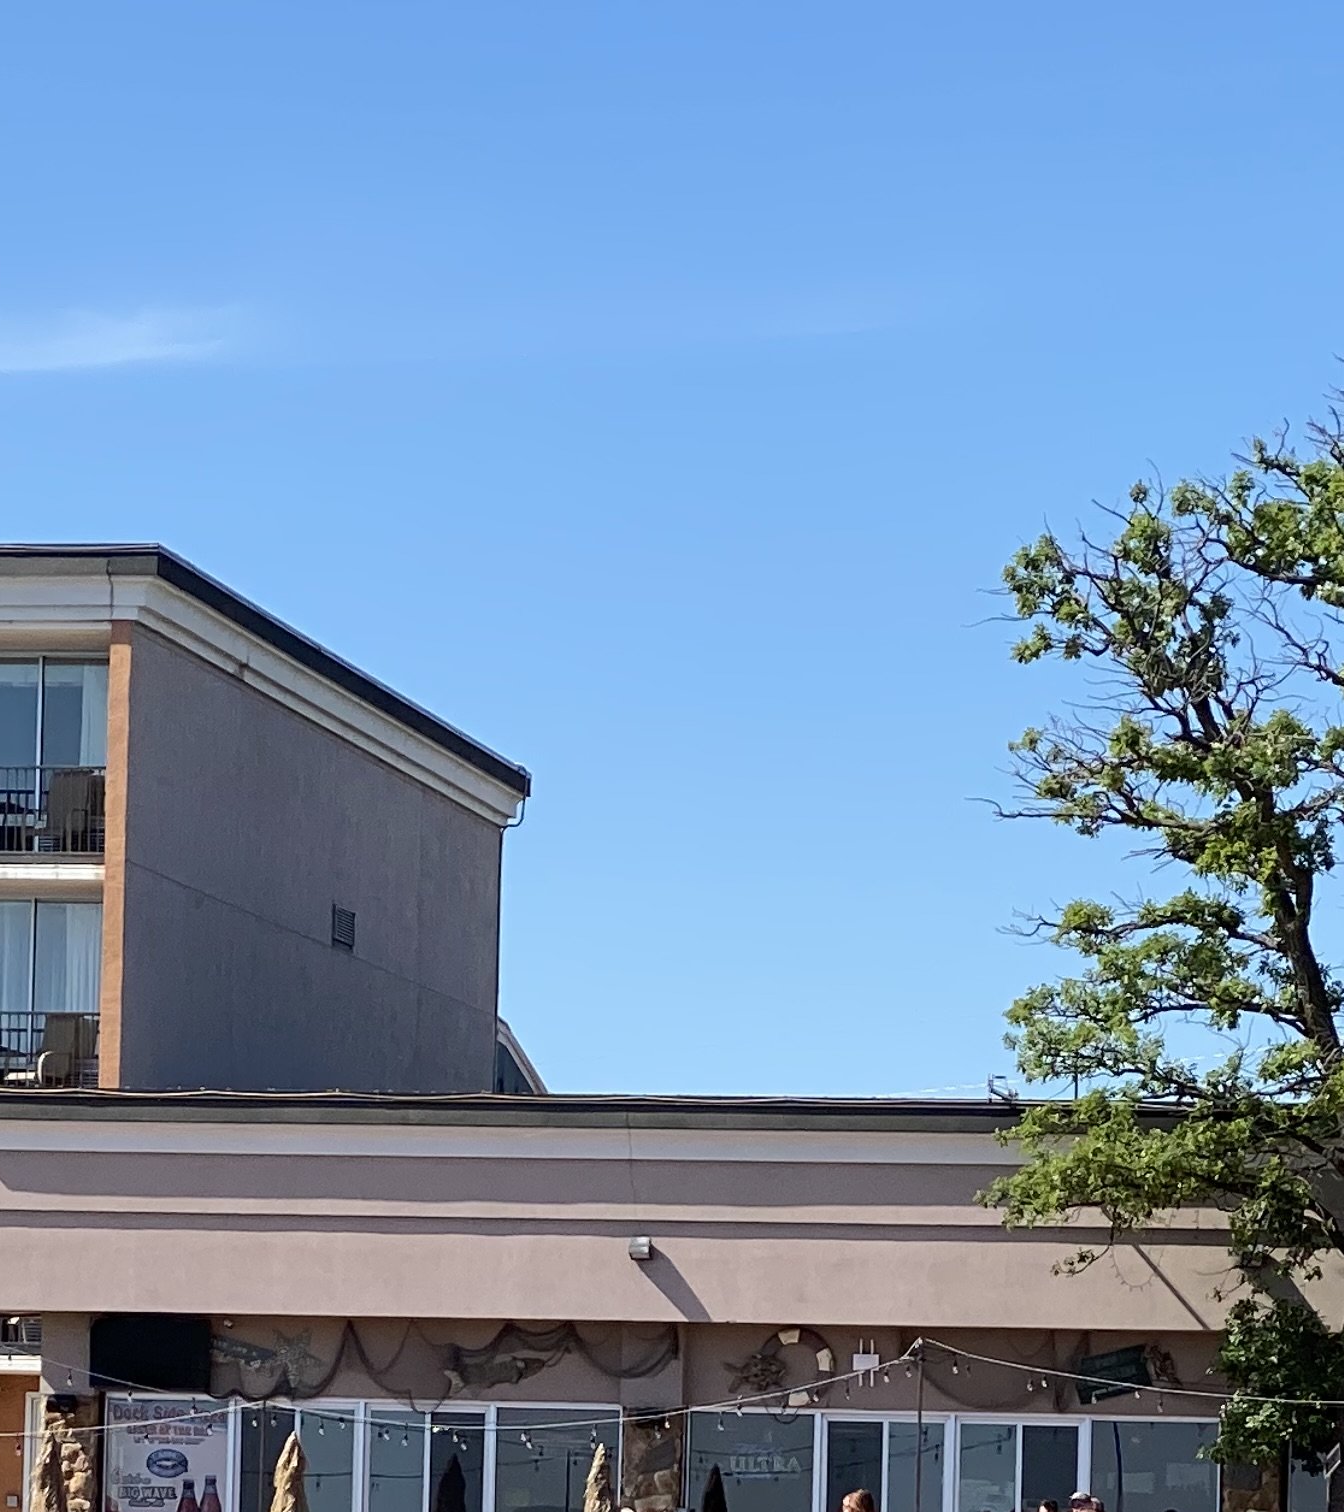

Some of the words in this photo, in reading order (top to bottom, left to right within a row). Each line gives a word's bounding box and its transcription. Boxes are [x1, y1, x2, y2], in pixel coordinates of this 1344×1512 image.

[113, 1404, 149, 1421] Dock
[730, 1455, 802, 1473] ULTRA
[119, 1487, 140, 1499] BIG
[143, 1487, 176, 1500] WAVE
